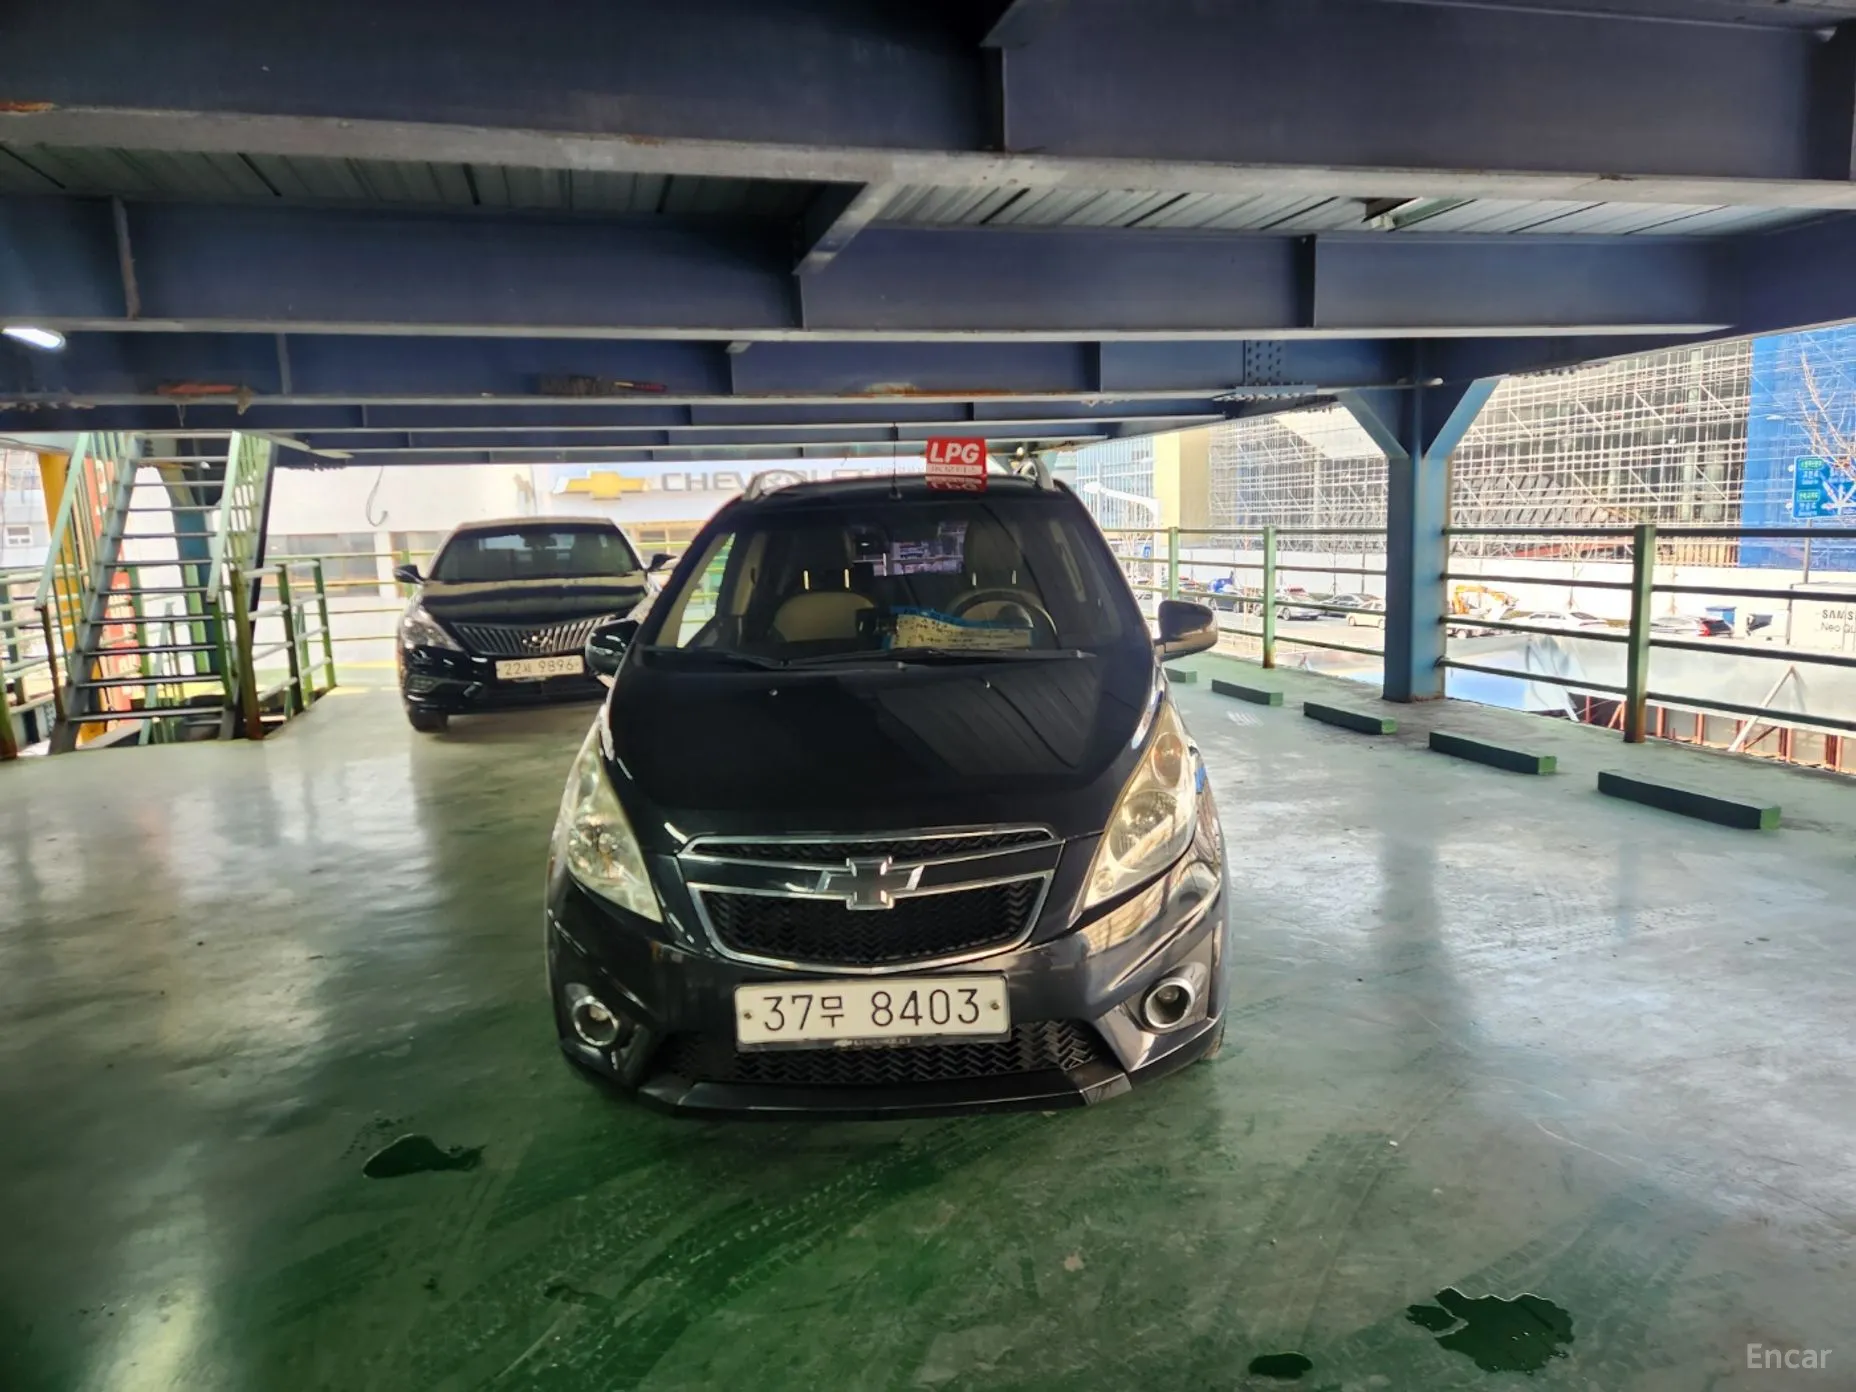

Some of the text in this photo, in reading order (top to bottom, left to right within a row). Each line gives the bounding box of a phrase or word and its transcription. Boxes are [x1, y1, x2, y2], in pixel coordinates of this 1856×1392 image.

[930, 442, 980, 464] LPG
[661, 469, 870, 492] CHEVL
[1822, 609, 1856, 620] SAMS
[763, 988, 980, 1031] 37무 8403
